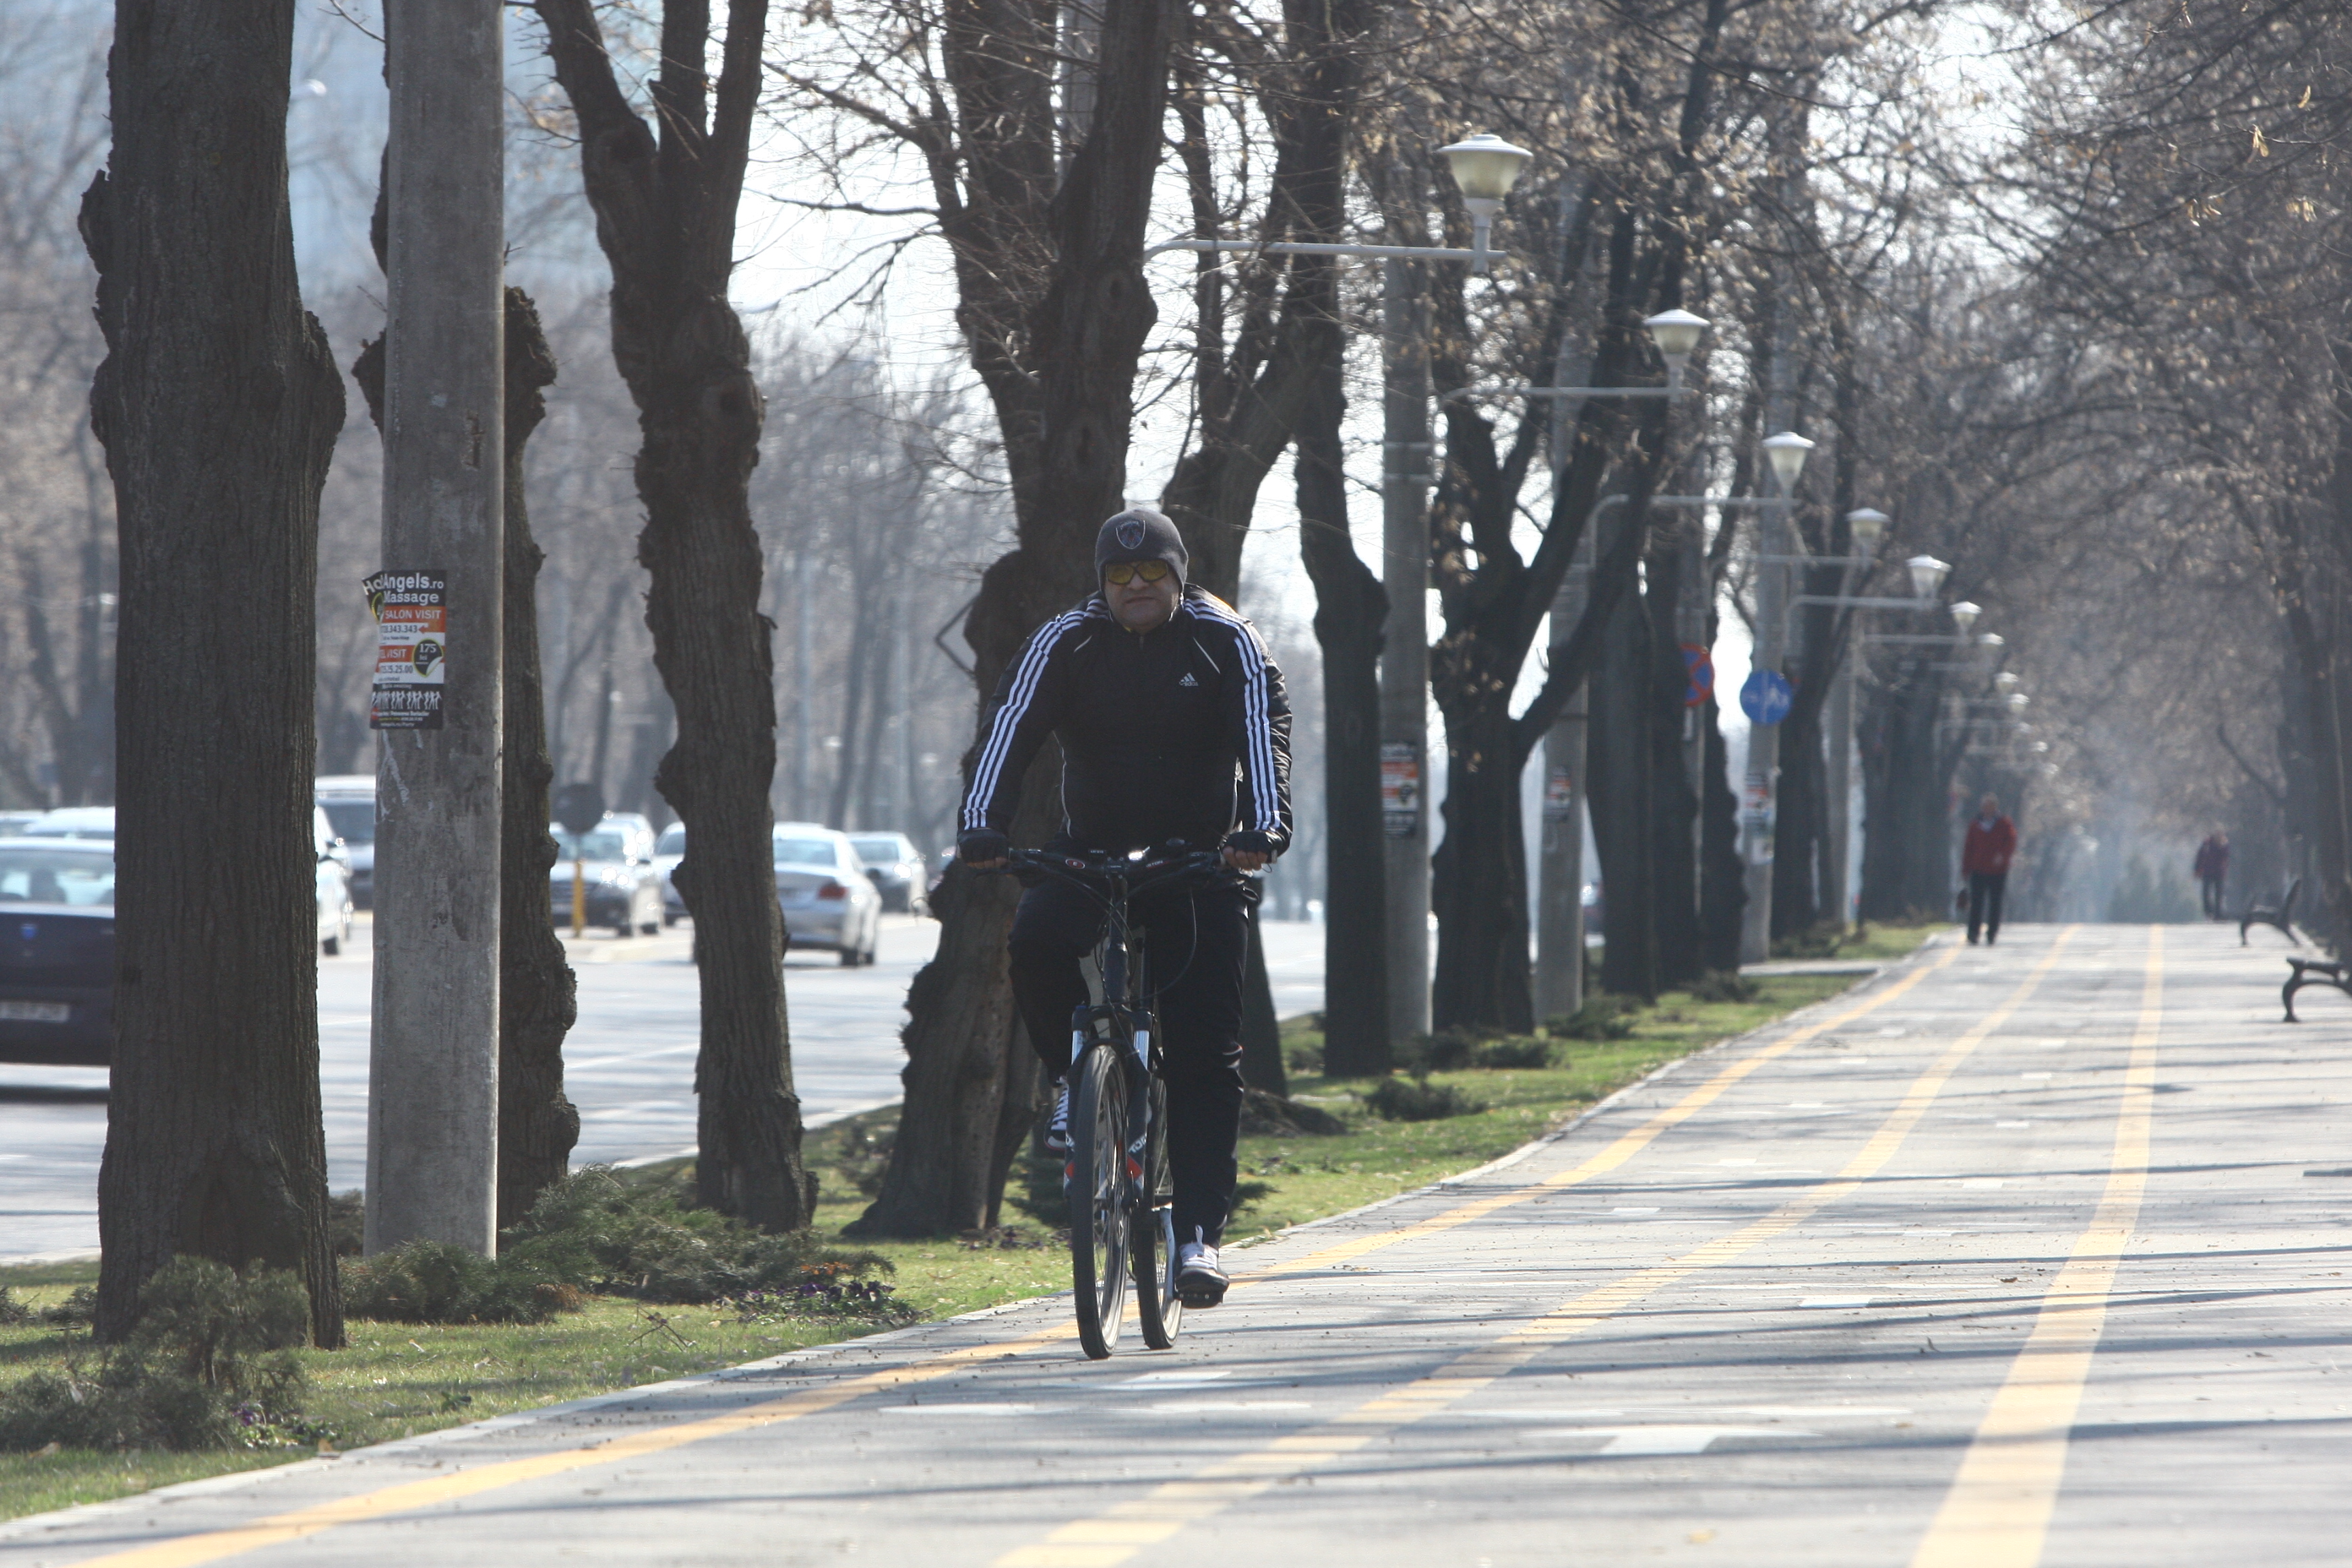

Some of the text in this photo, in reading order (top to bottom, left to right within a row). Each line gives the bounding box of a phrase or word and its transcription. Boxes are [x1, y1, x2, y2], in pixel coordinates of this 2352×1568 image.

[383, 590, 439, 606] Massage
[385, 610, 442, 619] SALON VISIT
[419, 643, 436, 653] 175
